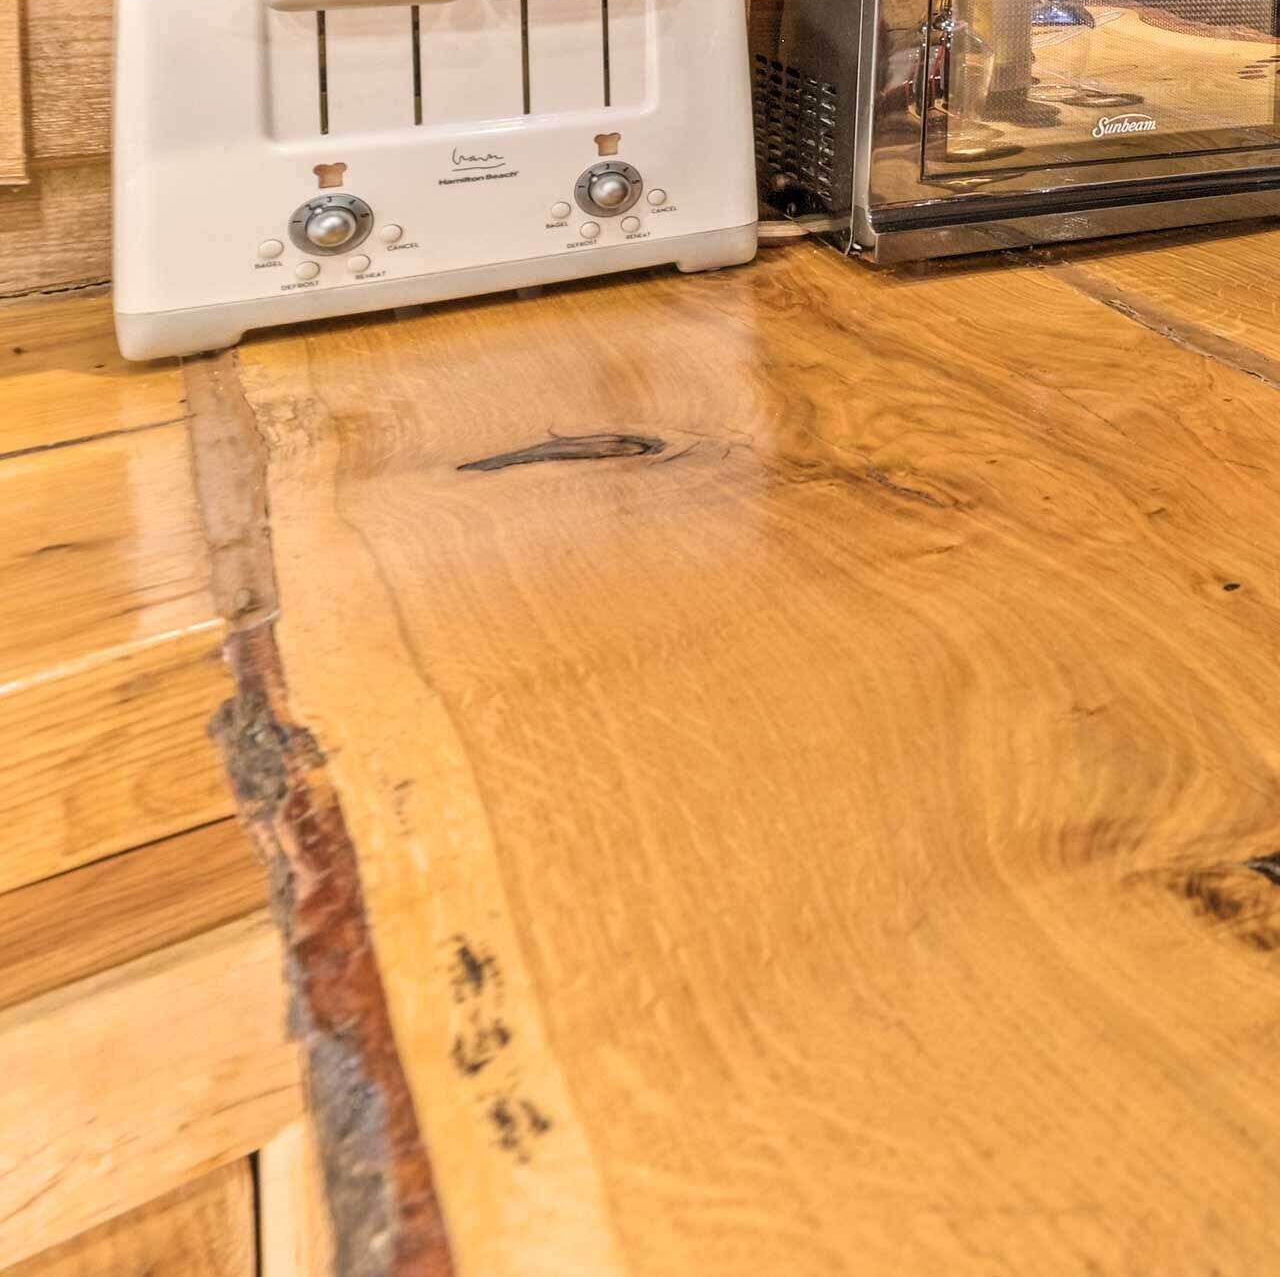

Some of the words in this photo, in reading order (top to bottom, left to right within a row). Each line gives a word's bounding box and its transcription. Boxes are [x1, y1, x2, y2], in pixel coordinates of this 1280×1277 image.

[1092, 116, 1157, 139] Sunbeam
[438, 175, 485, 186] Hamilton
[485, 170, 519, 181] Beach
[386, 242, 420, 253] CANCEL
[254, 260, 284, 270] BAGEL
[354, 270, 387, 281] REHEAT
[280, 279, 320, 292] DEFROST
